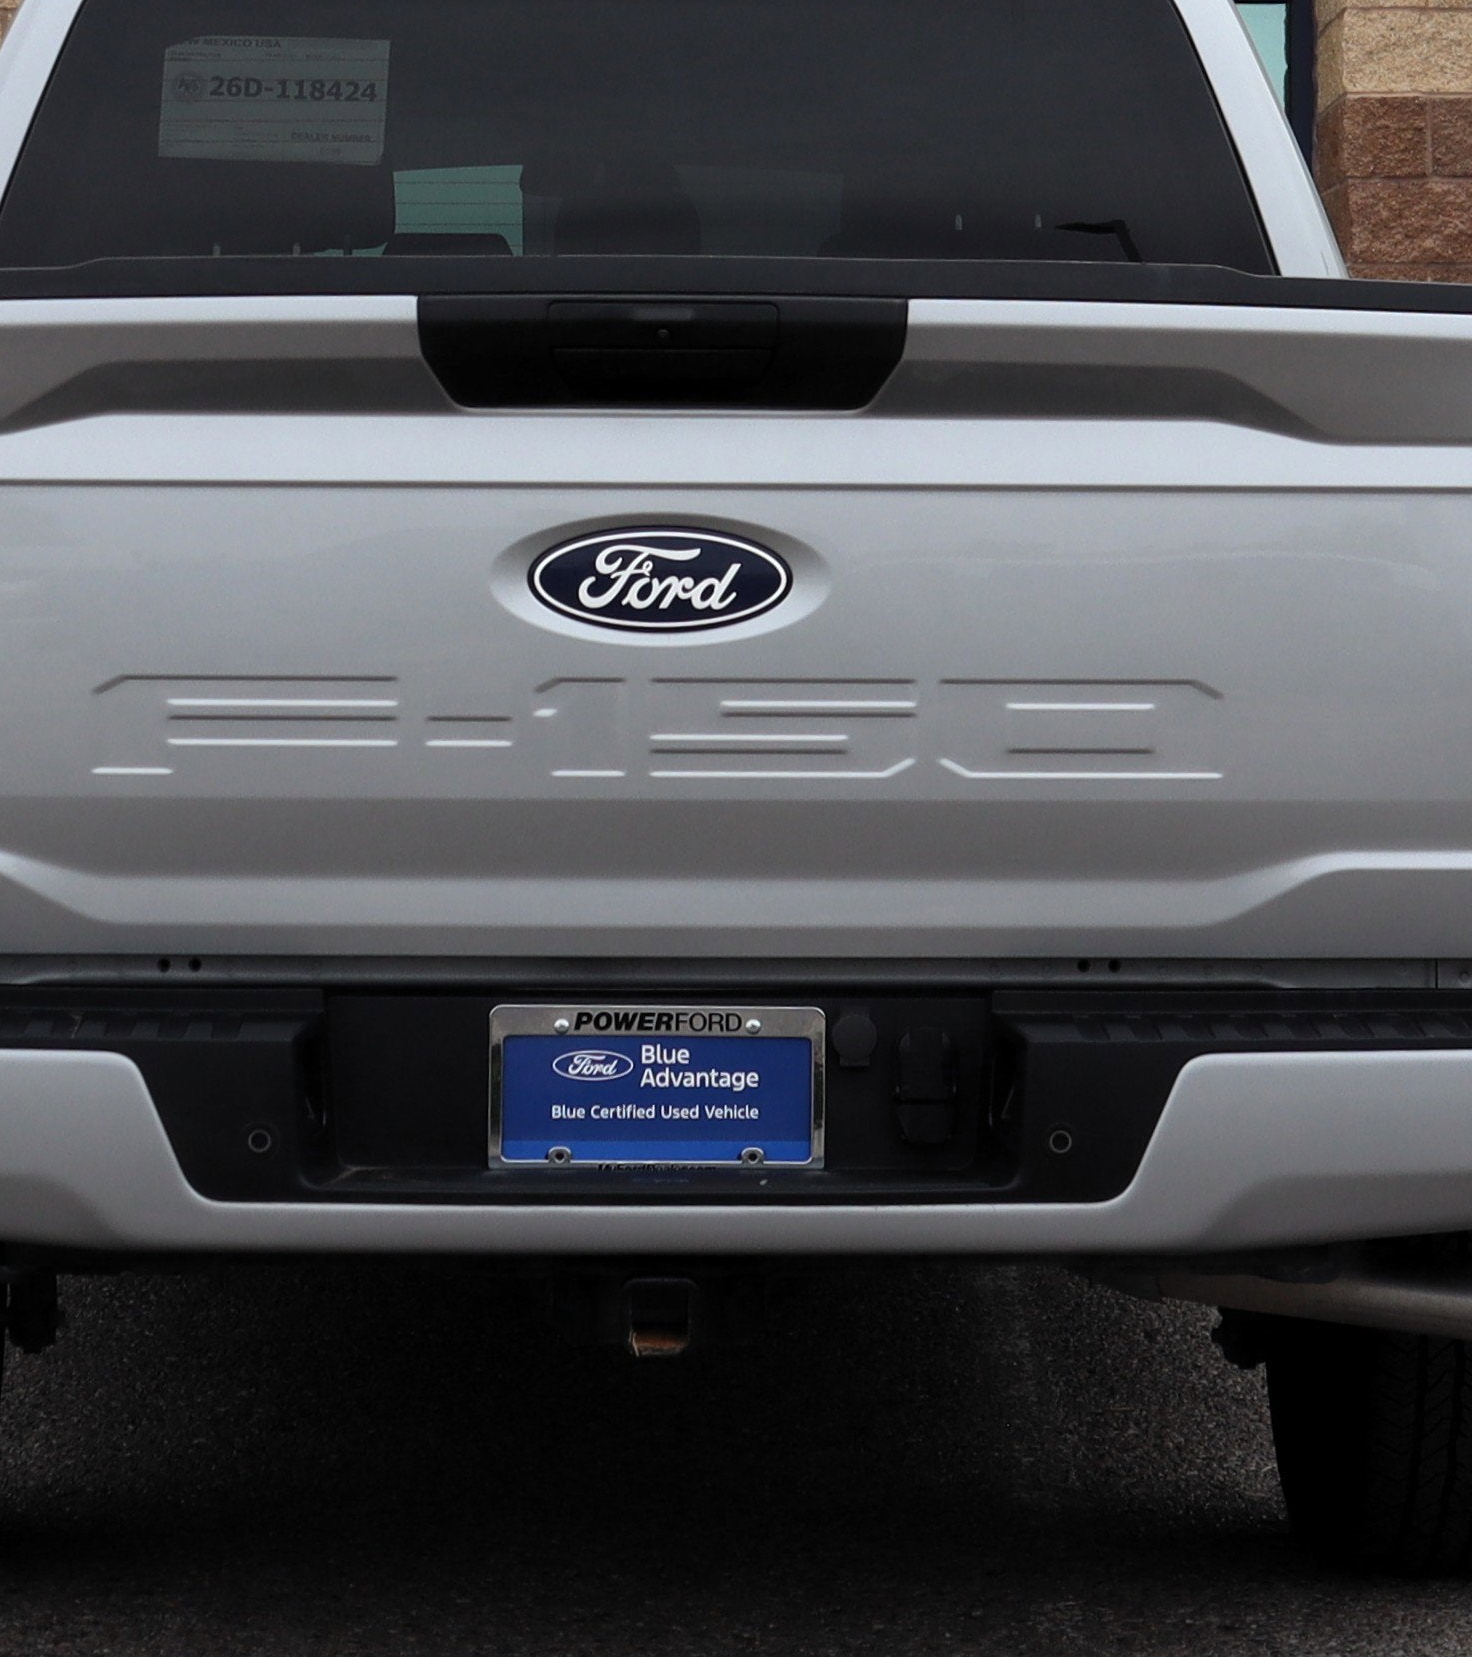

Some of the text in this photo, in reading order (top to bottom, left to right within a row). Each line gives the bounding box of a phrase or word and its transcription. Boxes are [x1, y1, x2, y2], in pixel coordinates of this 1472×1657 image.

[255, 38, 282, 48] USA
[209, 75, 378, 103] 26D-118424
[577, 544, 737, 612] Ford
[573, 1011, 743, 1033] POWERFORD
[567, 1054, 619, 1077] Ford
[640, 1044, 691, 1065] Blue
[639, 1067, 760, 1092] Advantage
[551, 1104, 760, 1120] Blue Certified Used Vehicle
